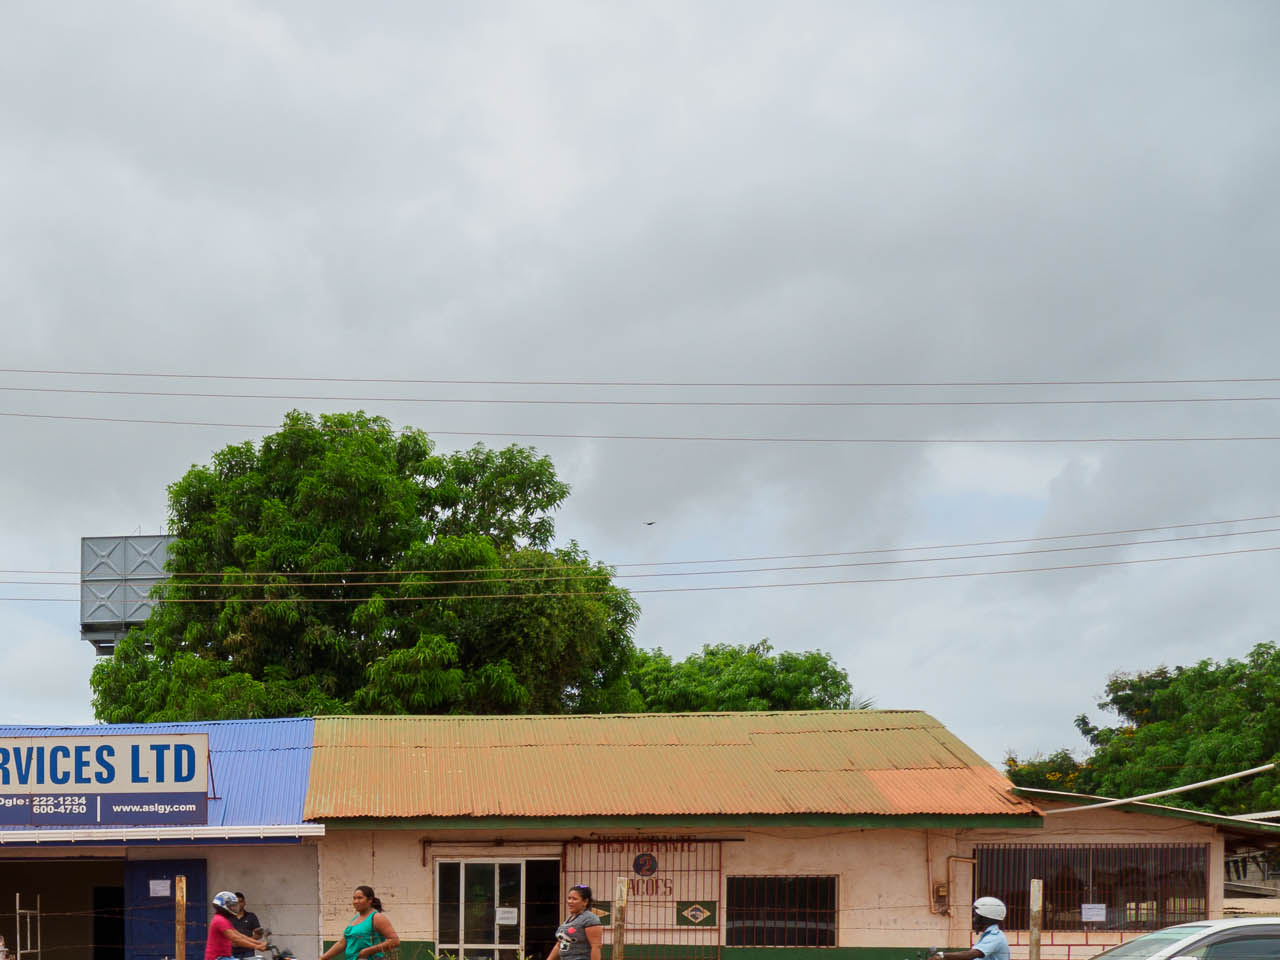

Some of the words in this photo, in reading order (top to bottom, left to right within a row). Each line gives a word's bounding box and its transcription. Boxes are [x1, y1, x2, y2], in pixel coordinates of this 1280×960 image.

[131, 743, 196, 784] LTD
[32, 796, 87, 805] 222-1234
[32, 805, 87, 814] 600-4750
[112, 803, 197, 813] www.aslgy.com
[639, 855, 652, 876] 2
